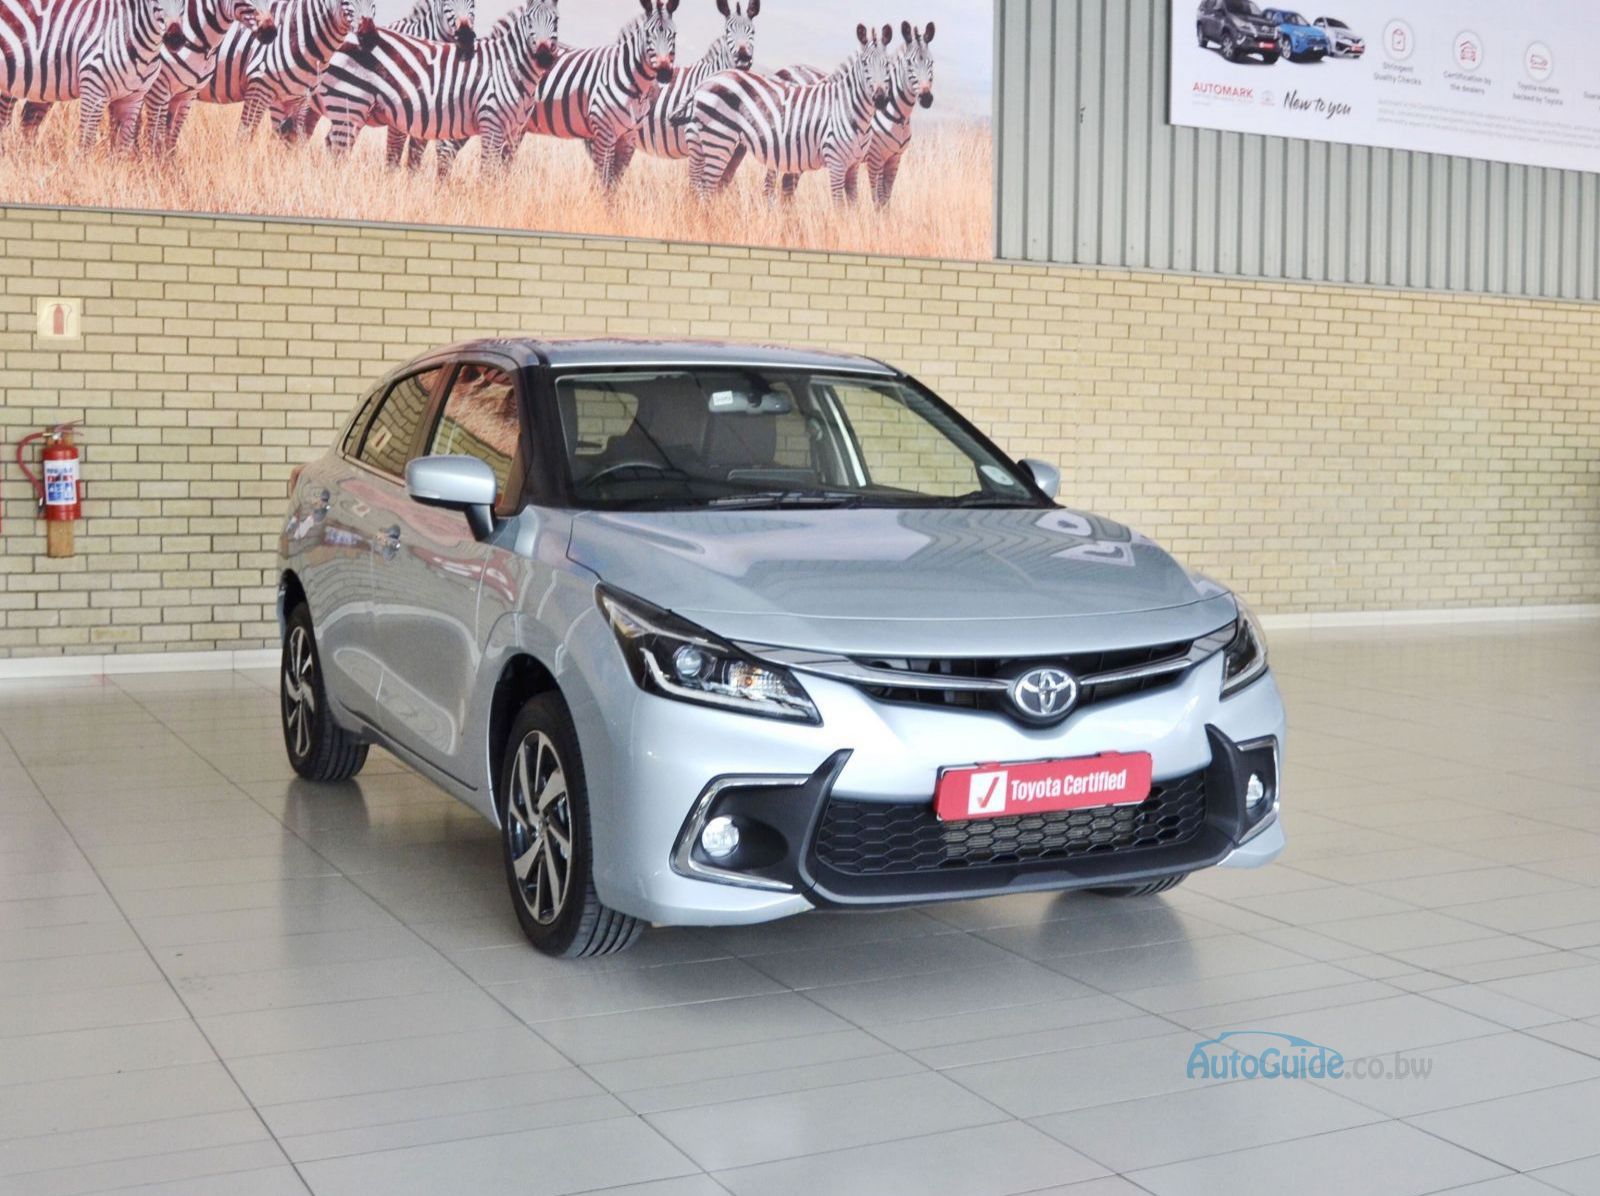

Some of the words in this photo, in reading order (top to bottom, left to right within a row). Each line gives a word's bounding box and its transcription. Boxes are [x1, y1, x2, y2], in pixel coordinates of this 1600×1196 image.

[1192, 82, 1254, 98] AUTOMARK
[1283, 89, 1312, 111] New
[1314, 97, 1326, 112] to
[1326, 101, 1351, 120] you
[1011, 777, 1062, 801] Toyota
[1064, 769, 1127, 795] Certified
